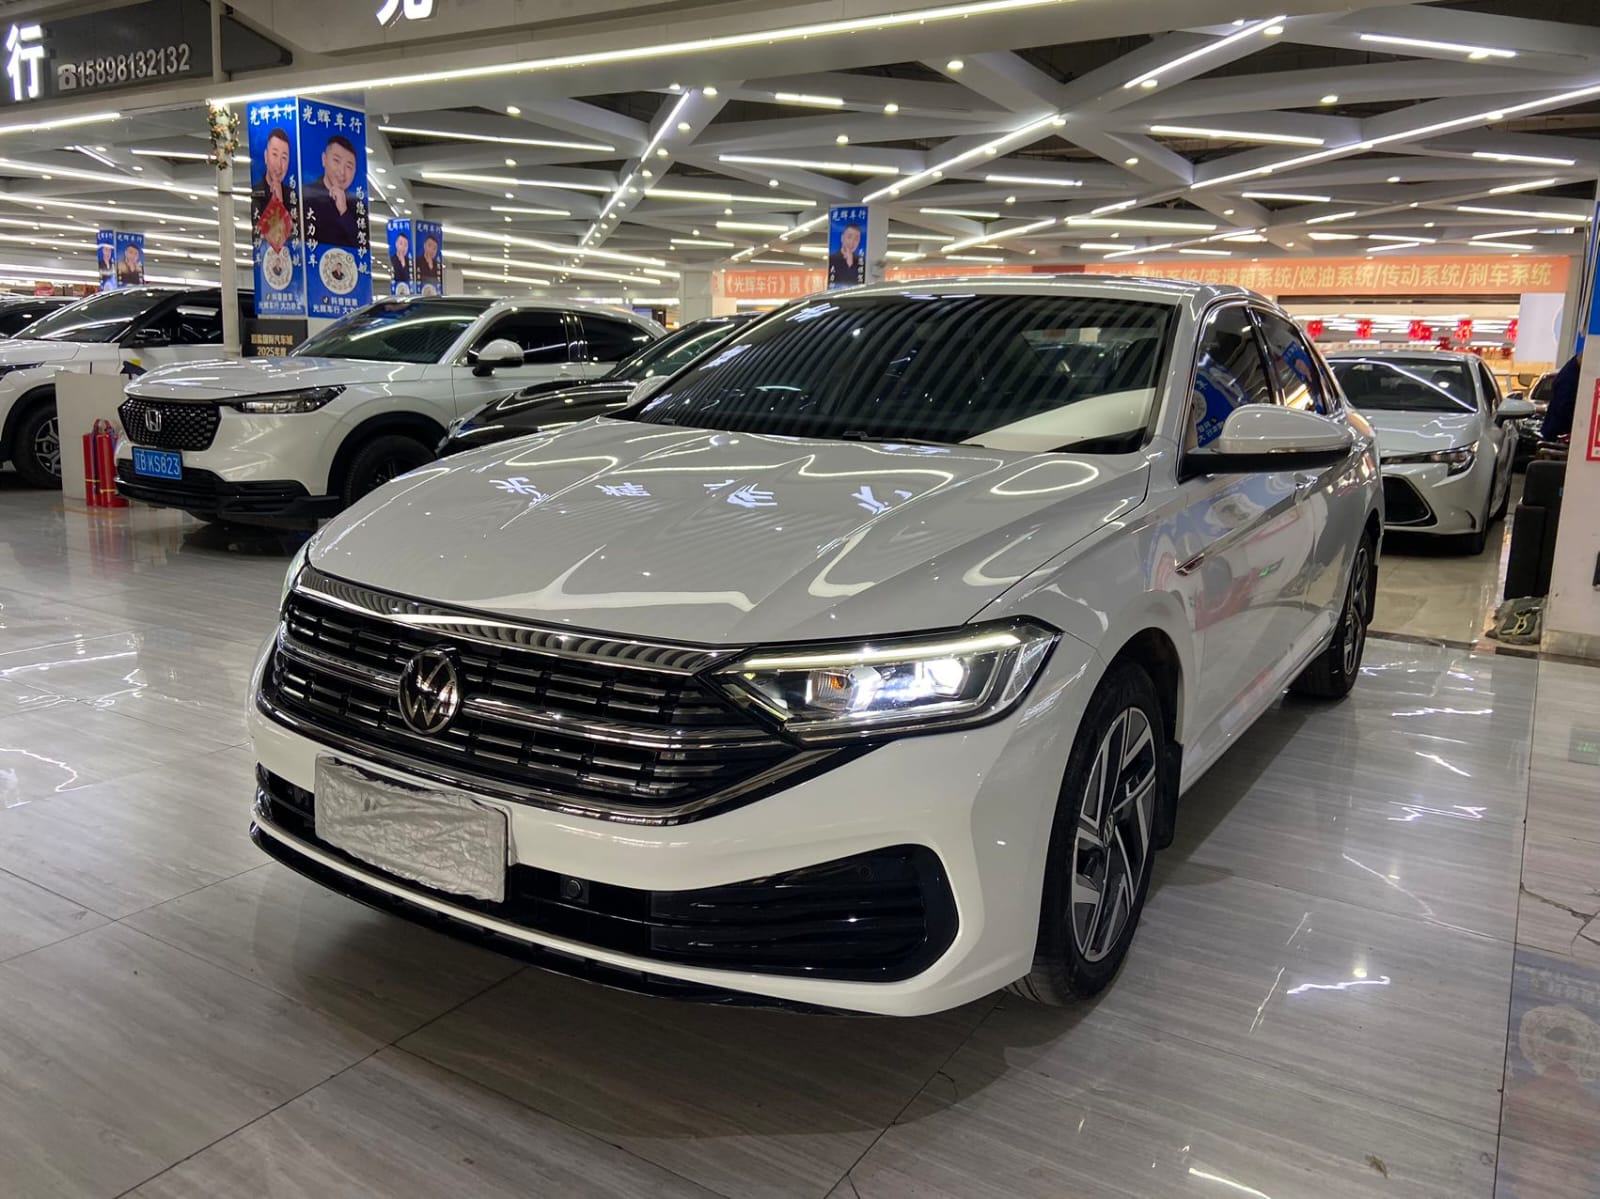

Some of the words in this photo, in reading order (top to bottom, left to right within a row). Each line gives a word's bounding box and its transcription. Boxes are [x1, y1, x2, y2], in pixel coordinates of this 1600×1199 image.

[6, 24, 46, 102] 行
[76, 43, 191, 88] 15898132132
[250, 103, 294, 126] 光辉车行
[303, 105, 363, 135] 光辉车行
